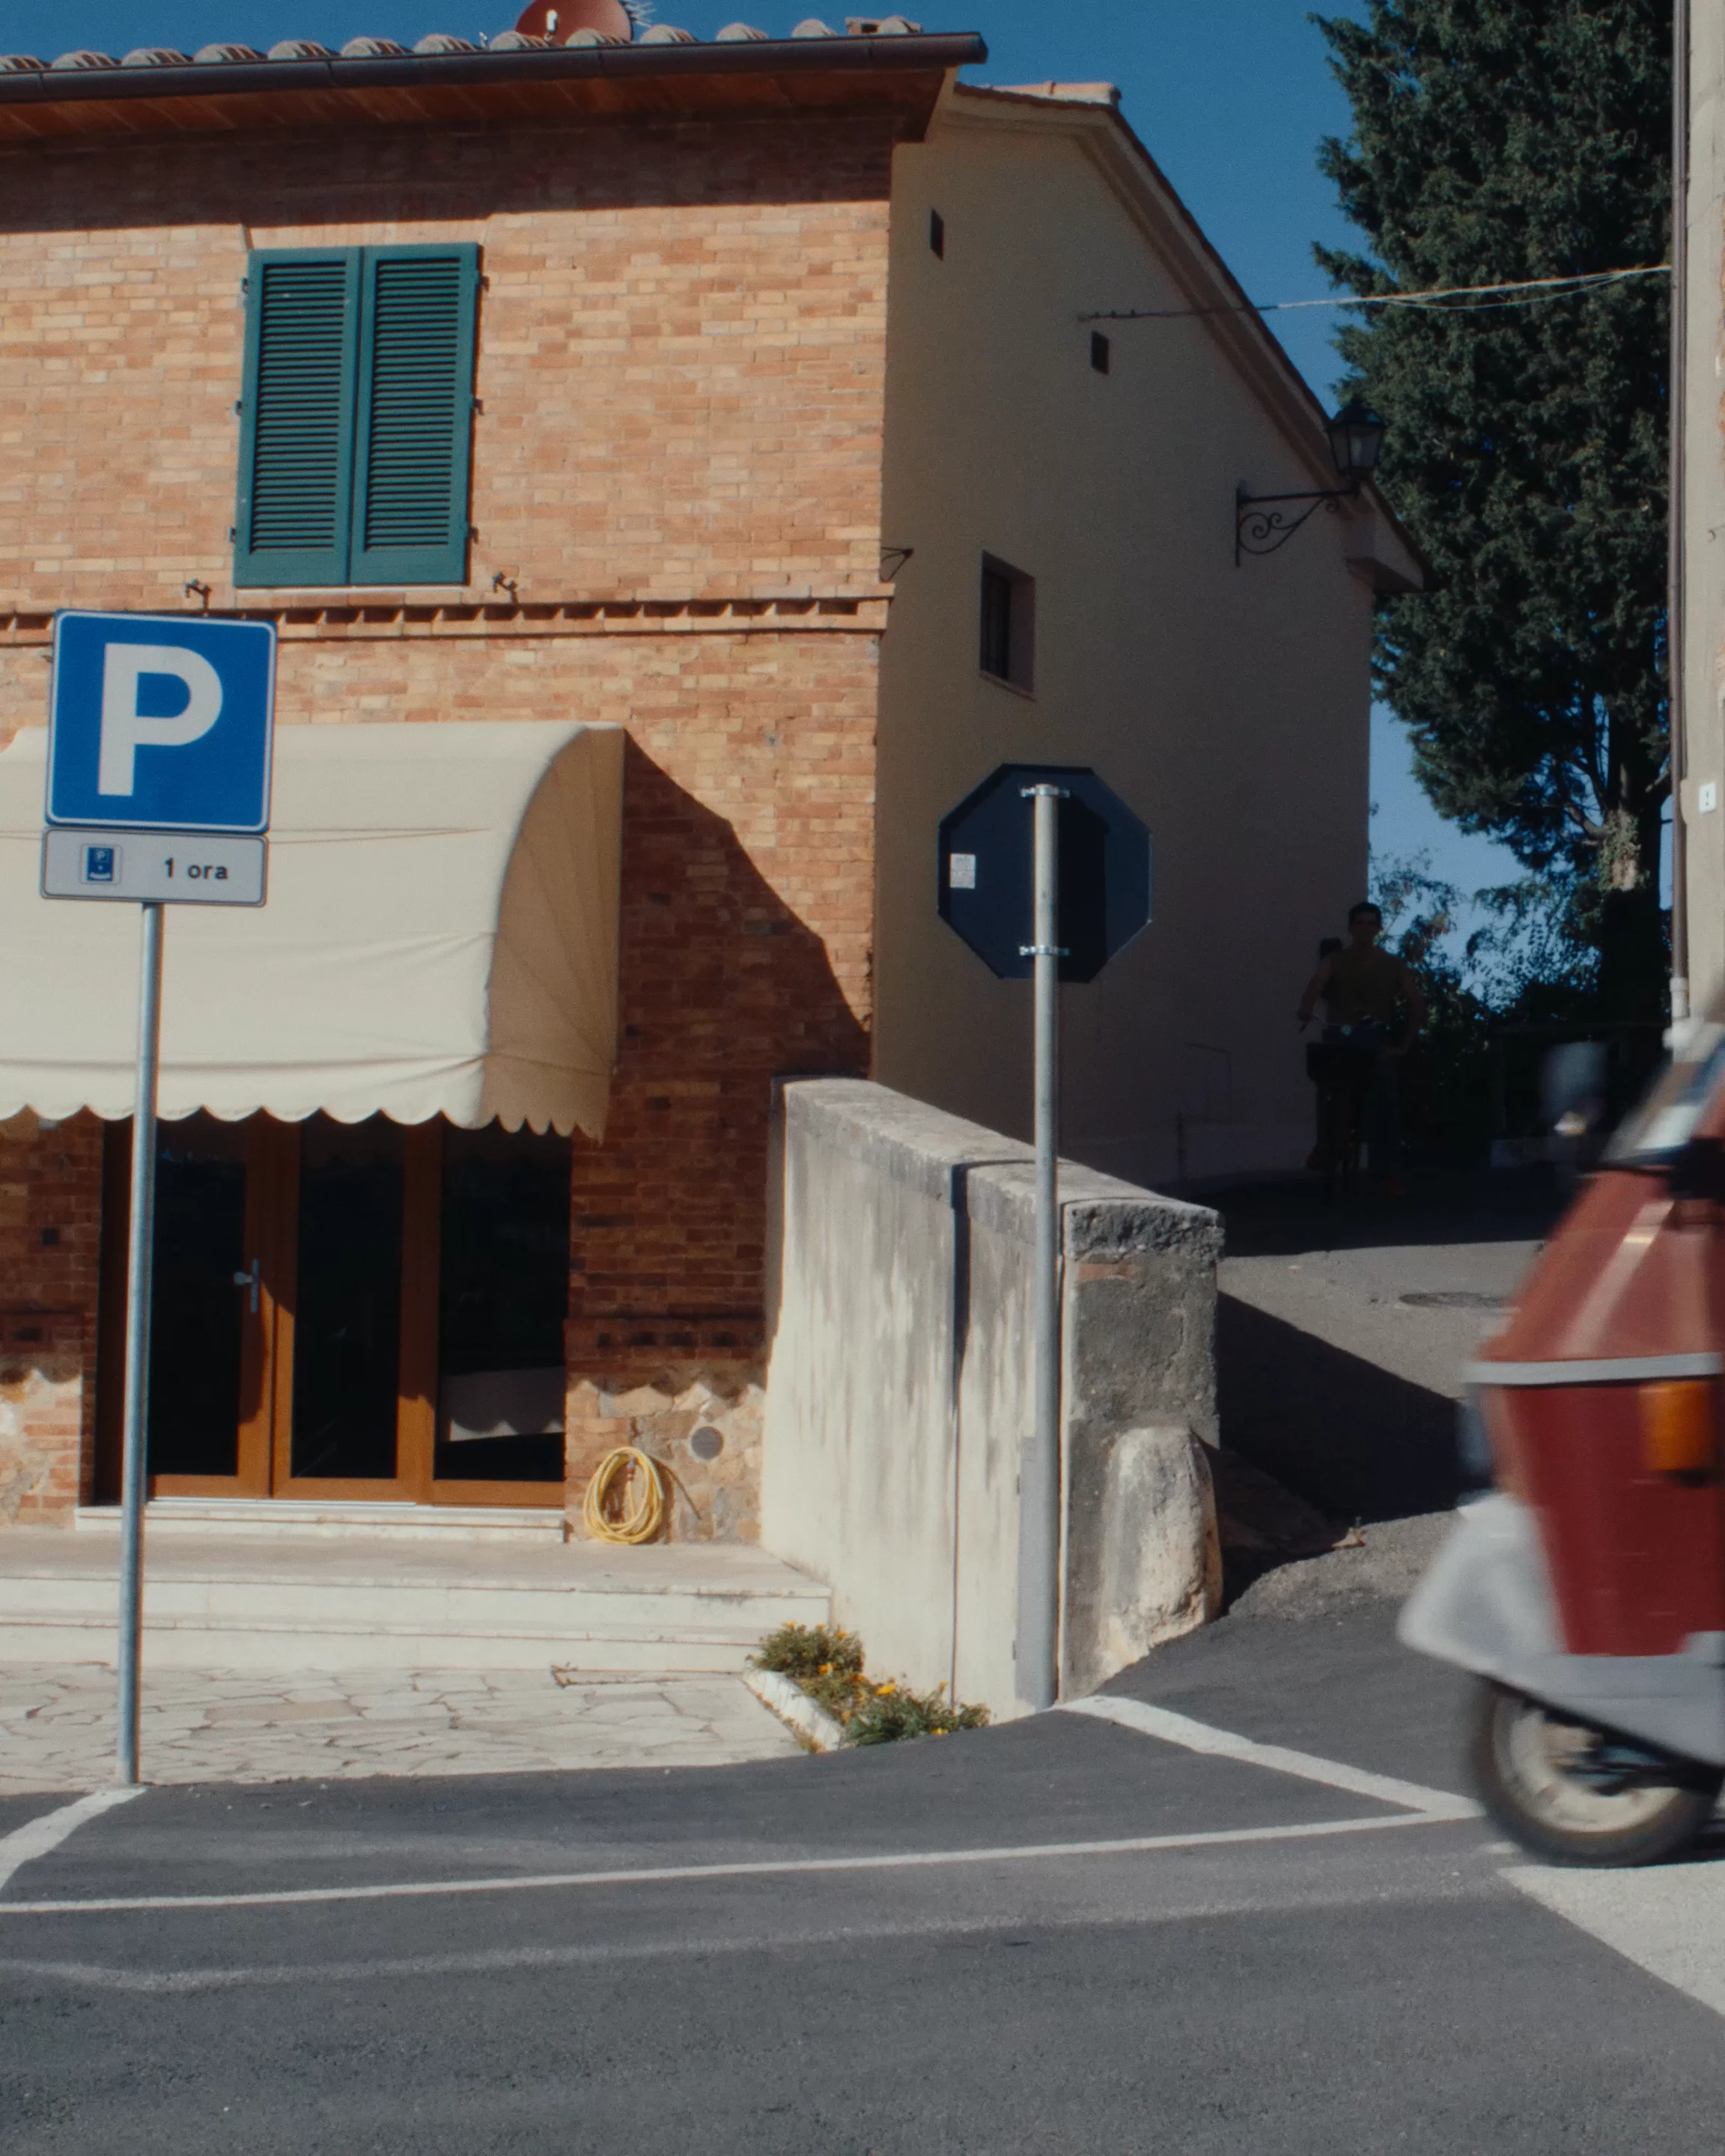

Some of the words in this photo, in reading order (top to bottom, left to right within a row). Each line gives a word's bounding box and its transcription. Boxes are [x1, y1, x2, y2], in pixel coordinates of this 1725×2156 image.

[98, 642, 223, 797] P
[164, 857, 174, 878] 1
[187, 865, 228, 880] ora
